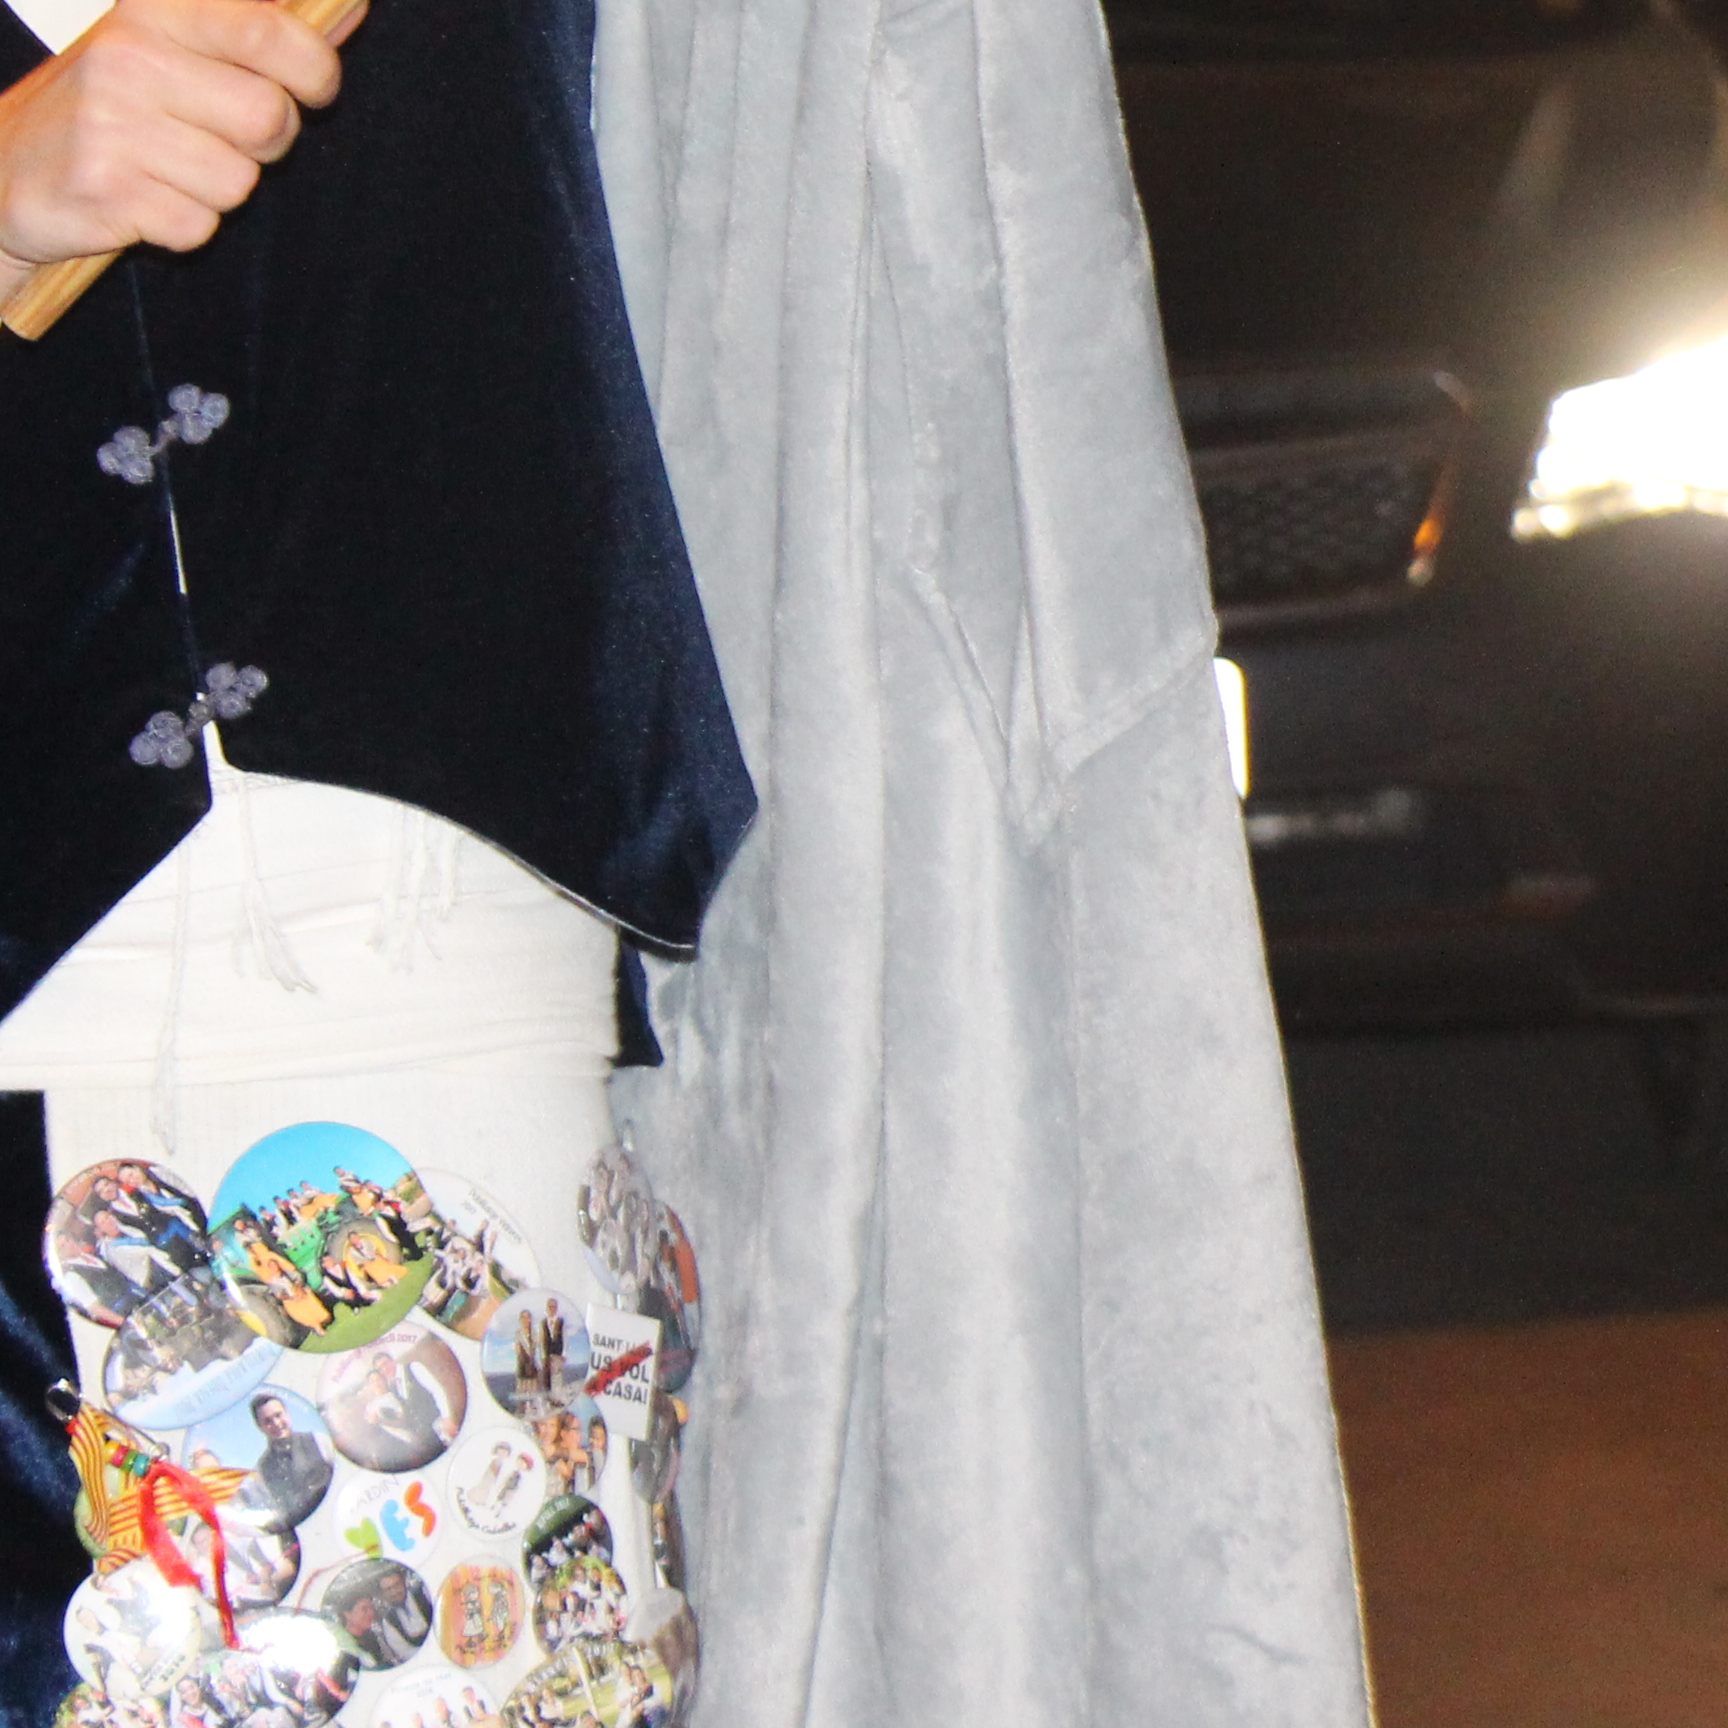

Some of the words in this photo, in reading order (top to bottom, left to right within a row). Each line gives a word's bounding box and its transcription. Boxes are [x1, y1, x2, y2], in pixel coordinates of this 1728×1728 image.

[592, 1333, 623, 1352] SANT
[591, 1352, 613, 1373] US
[603, 1379, 648, 1404] CASA!
